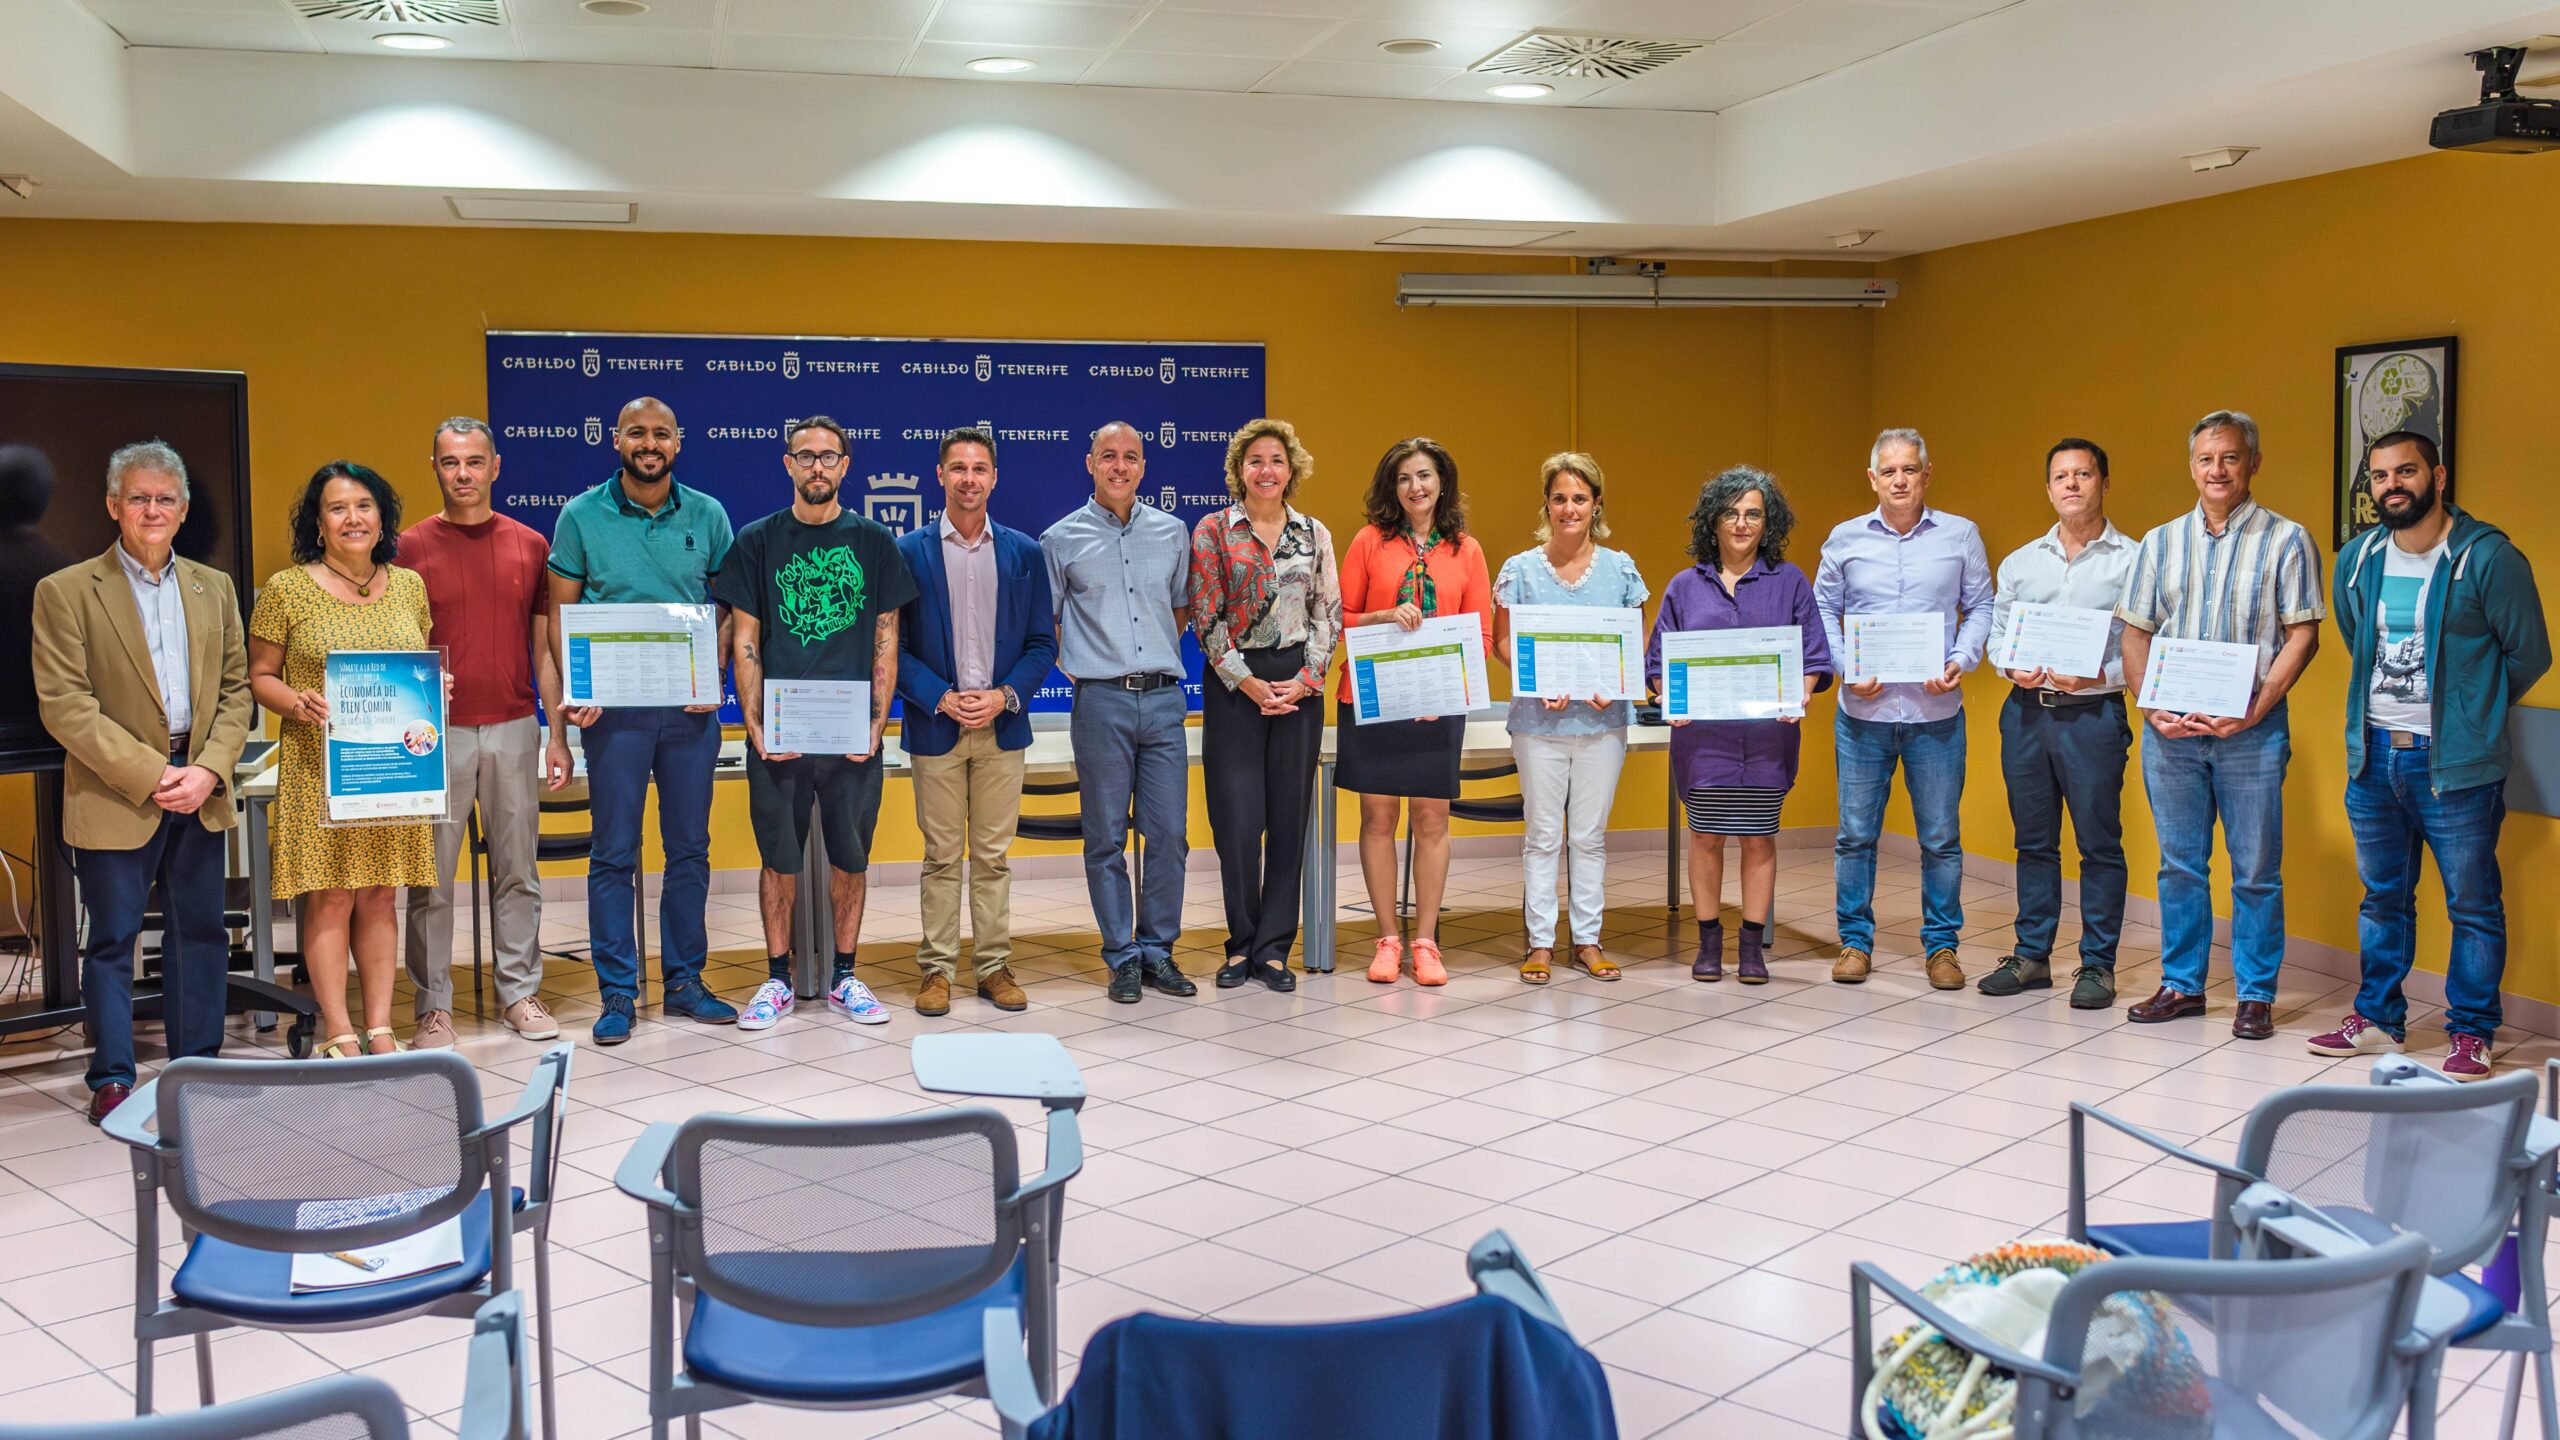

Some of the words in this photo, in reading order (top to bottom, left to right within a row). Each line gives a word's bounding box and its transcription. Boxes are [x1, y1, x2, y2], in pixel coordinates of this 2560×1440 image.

[502, 357, 576, 370] CABILDO
[607, 358, 684, 371] TENERIFE
[705, 359, 777, 372] CABILDO
[806, 360, 881, 373] TENERIFE
[901, 362, 969, 375] CABILDO
[998, 364, 1069, 377] TENERIFE
[1088, 365, 1155, 378] CABILDO
[1181, 367, 1250, 379] TENERIFE
[503, 426, 578, 439] CABILDO
[706, 427, 778, 440] CABILDO
[998, 429, 1069, 441] TENERIFE
[505, 494, 573, 506] CABILD
[340, 700, 360, 714] BIEN
[362, 698, 392, 713] COMÚN
